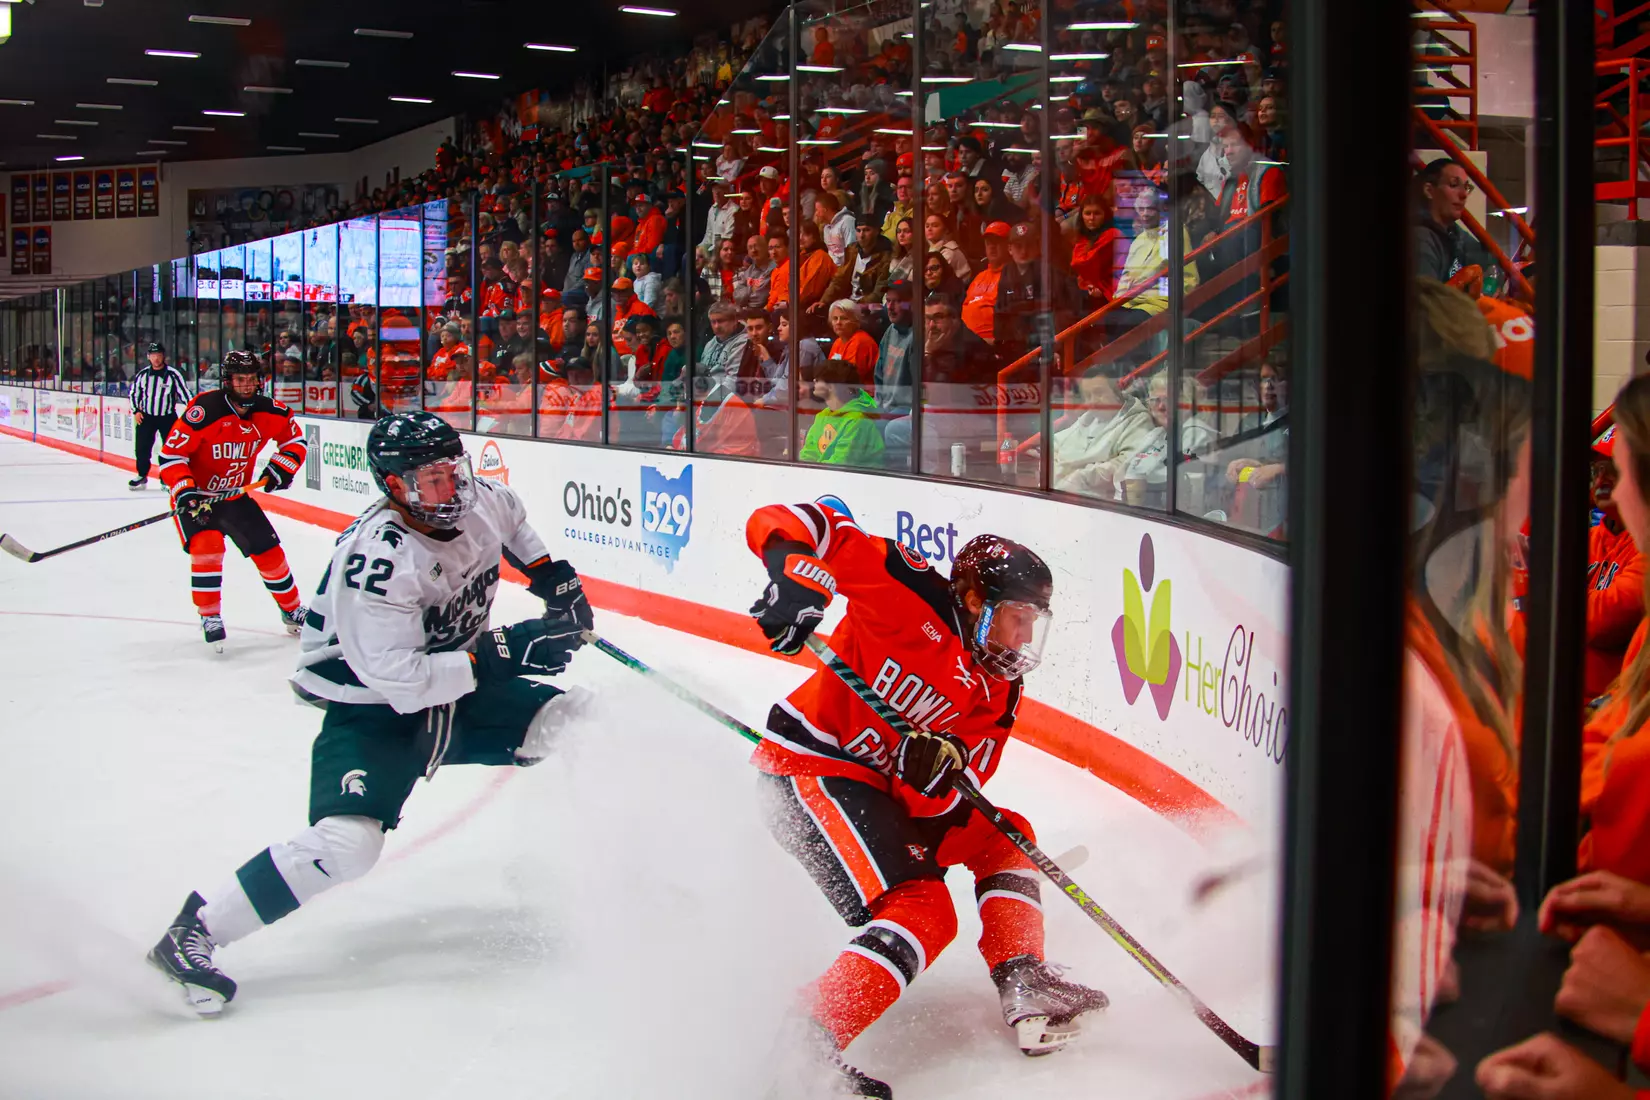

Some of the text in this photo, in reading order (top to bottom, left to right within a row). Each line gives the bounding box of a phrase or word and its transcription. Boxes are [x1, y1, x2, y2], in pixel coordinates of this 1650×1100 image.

[165, 429, 190, 449] 27
[226, 461, 248, 476] 27
[332, 473, 370, 495] rentals.com
[563, 480, 632, 527] Ohio's
[643, 491, 690, 537] 529
[897, 511, 958, 563] Best
[345, 553, 395, 596] 22
[1007, 832, 1064, 884] ALPHA
